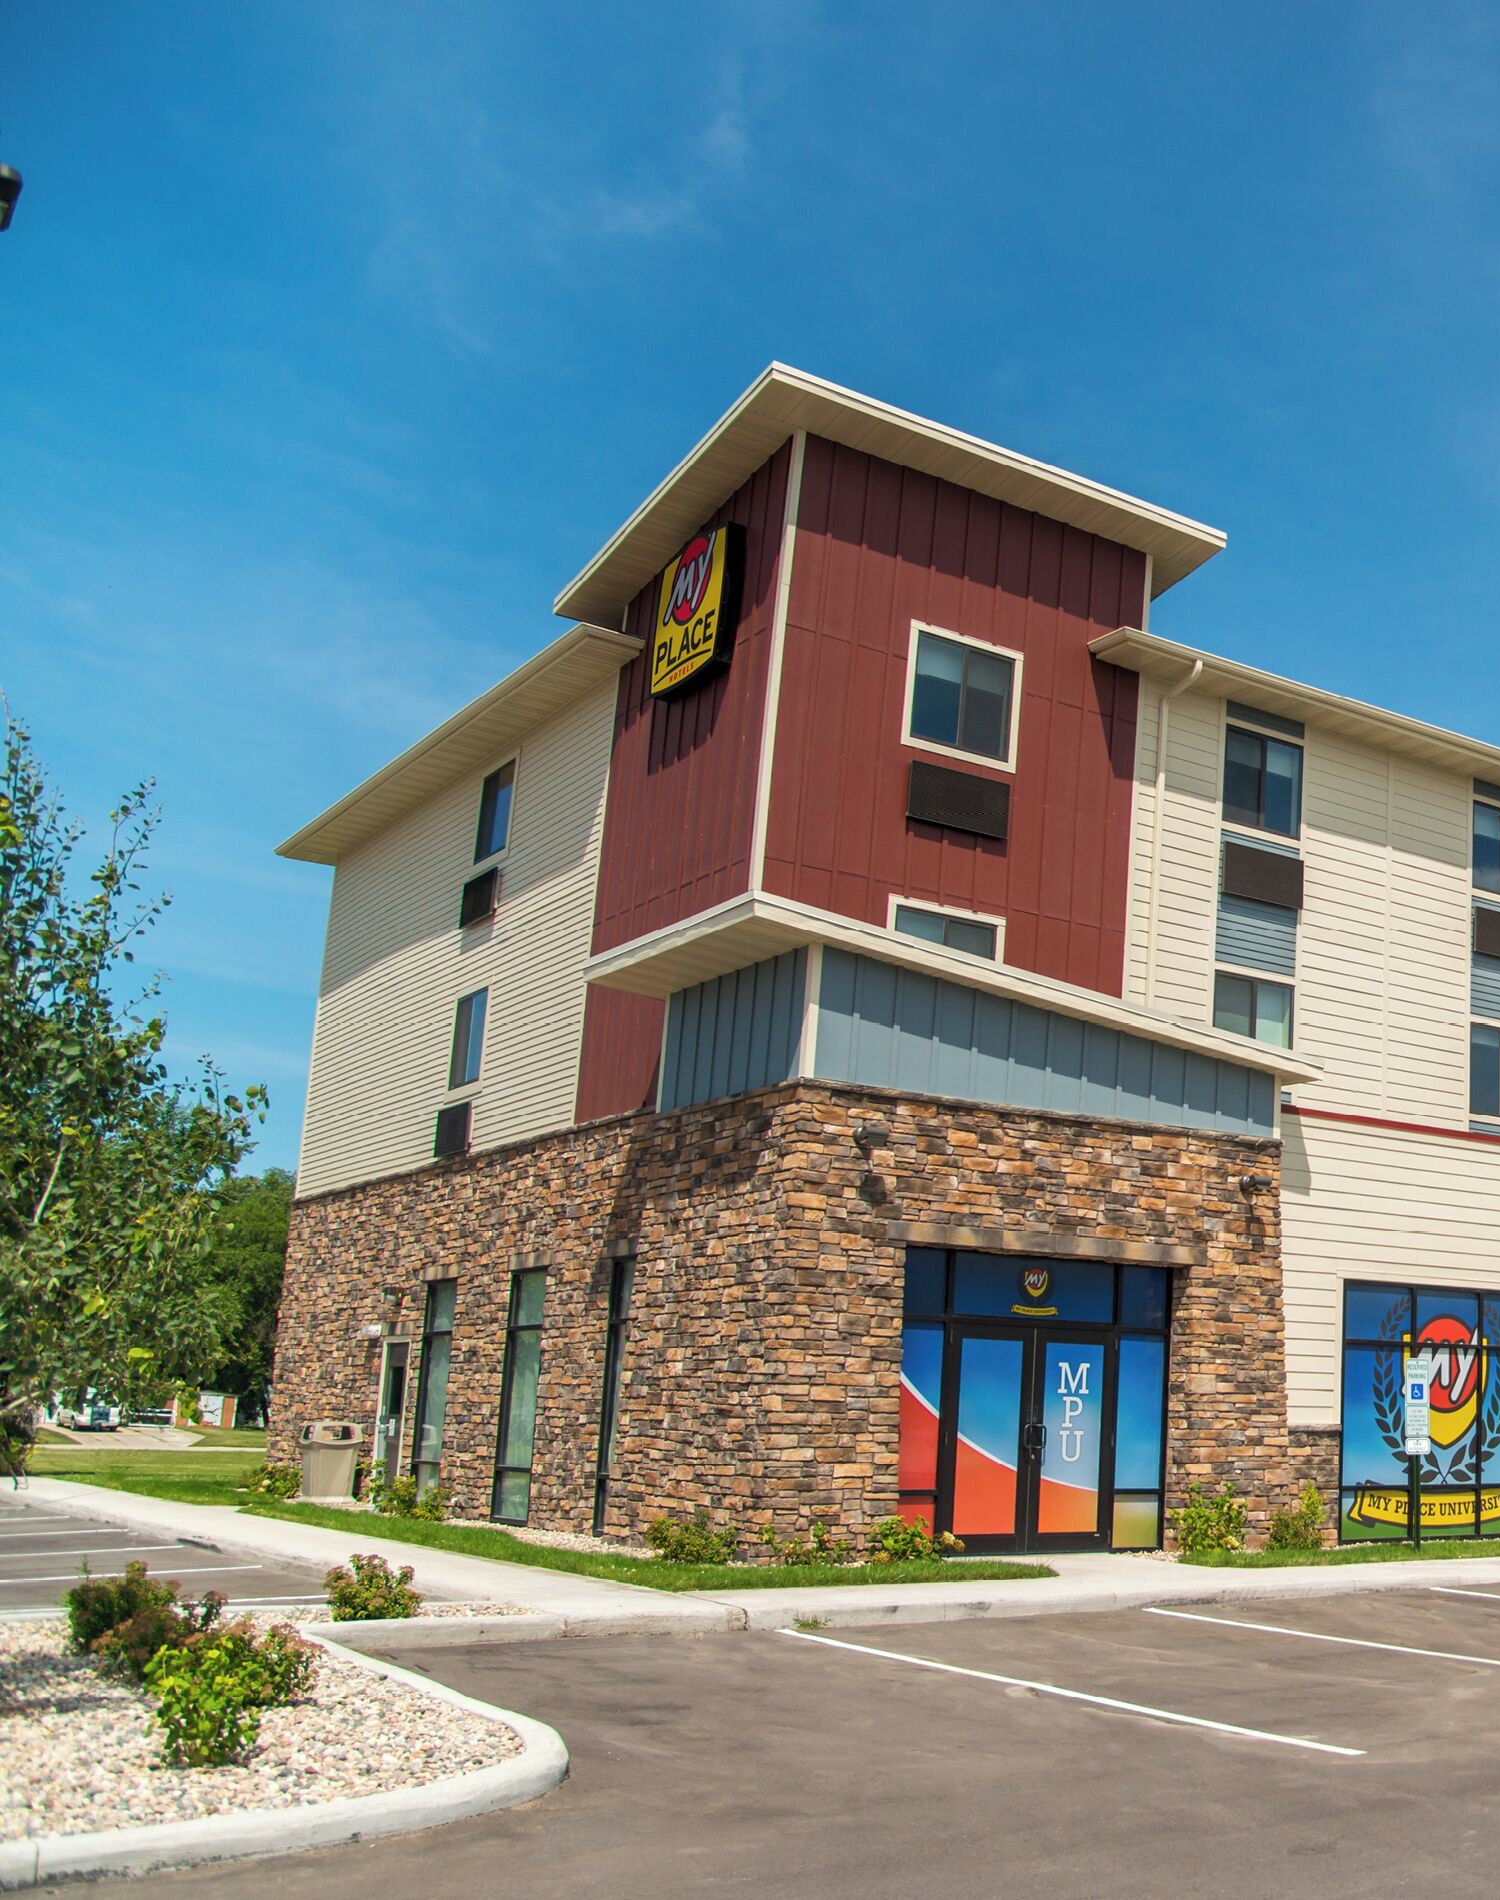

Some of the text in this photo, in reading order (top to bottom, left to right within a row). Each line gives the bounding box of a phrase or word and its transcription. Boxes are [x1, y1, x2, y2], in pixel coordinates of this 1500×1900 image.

[655, 608, 716, 675] PLACE
[668, 662, 695, 683] HOTELS
[1368, 1493, 1391, 1511] MY
[1394, 1499, 1435, 1516] PLCE
